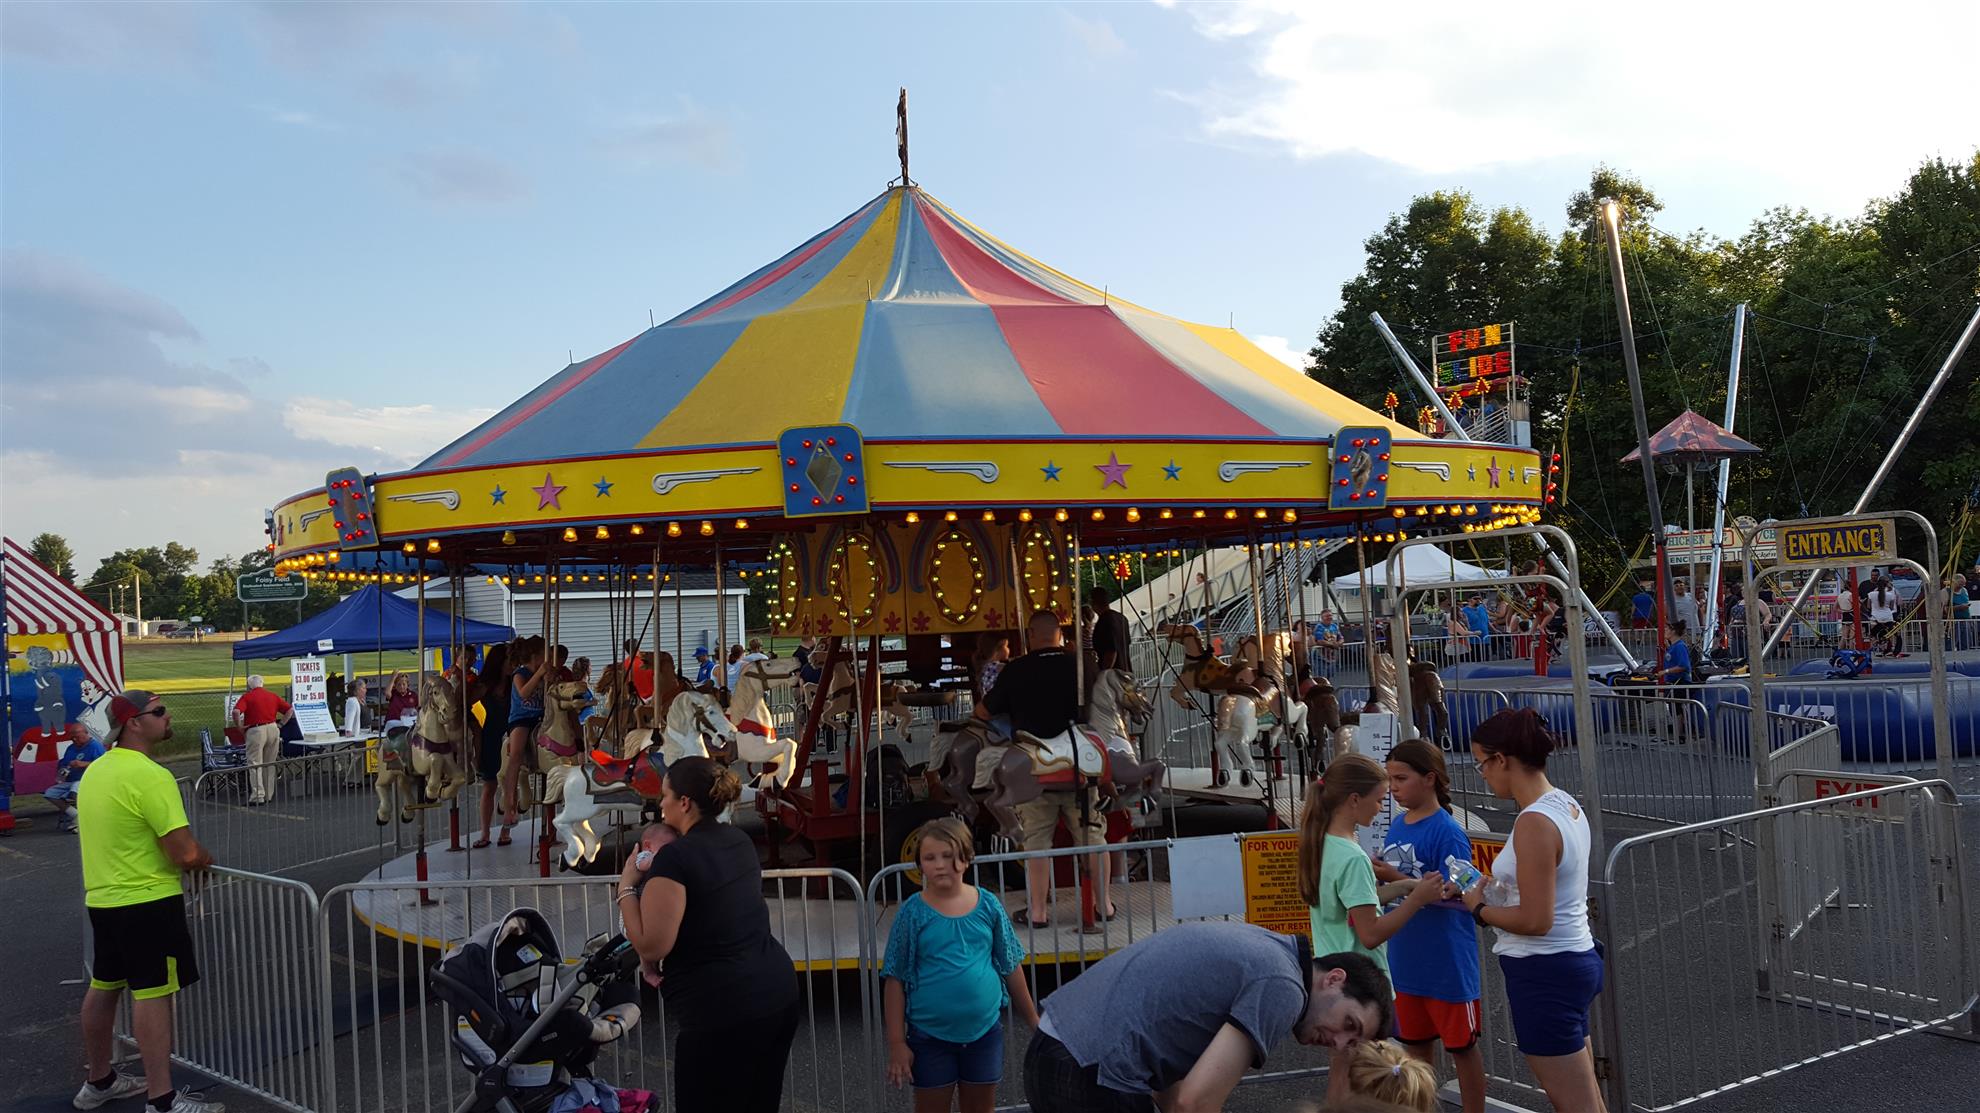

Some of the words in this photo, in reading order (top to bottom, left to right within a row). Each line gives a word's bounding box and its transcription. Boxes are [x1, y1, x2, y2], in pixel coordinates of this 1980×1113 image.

[1449, 324, 1501, 352] FUN
[1439, 351, 1511, 383] SLIDE
[1788, 527, 1881, 557] ENTRANCE
[296, 662, 320, 671] TICKETS
[295, 675, 310, 683] $3.00
[310, 692, 324, 700] $5.00
[1815, 779, 1883, 808] EXIT
[1247, 841, 1268, 851] FOR
